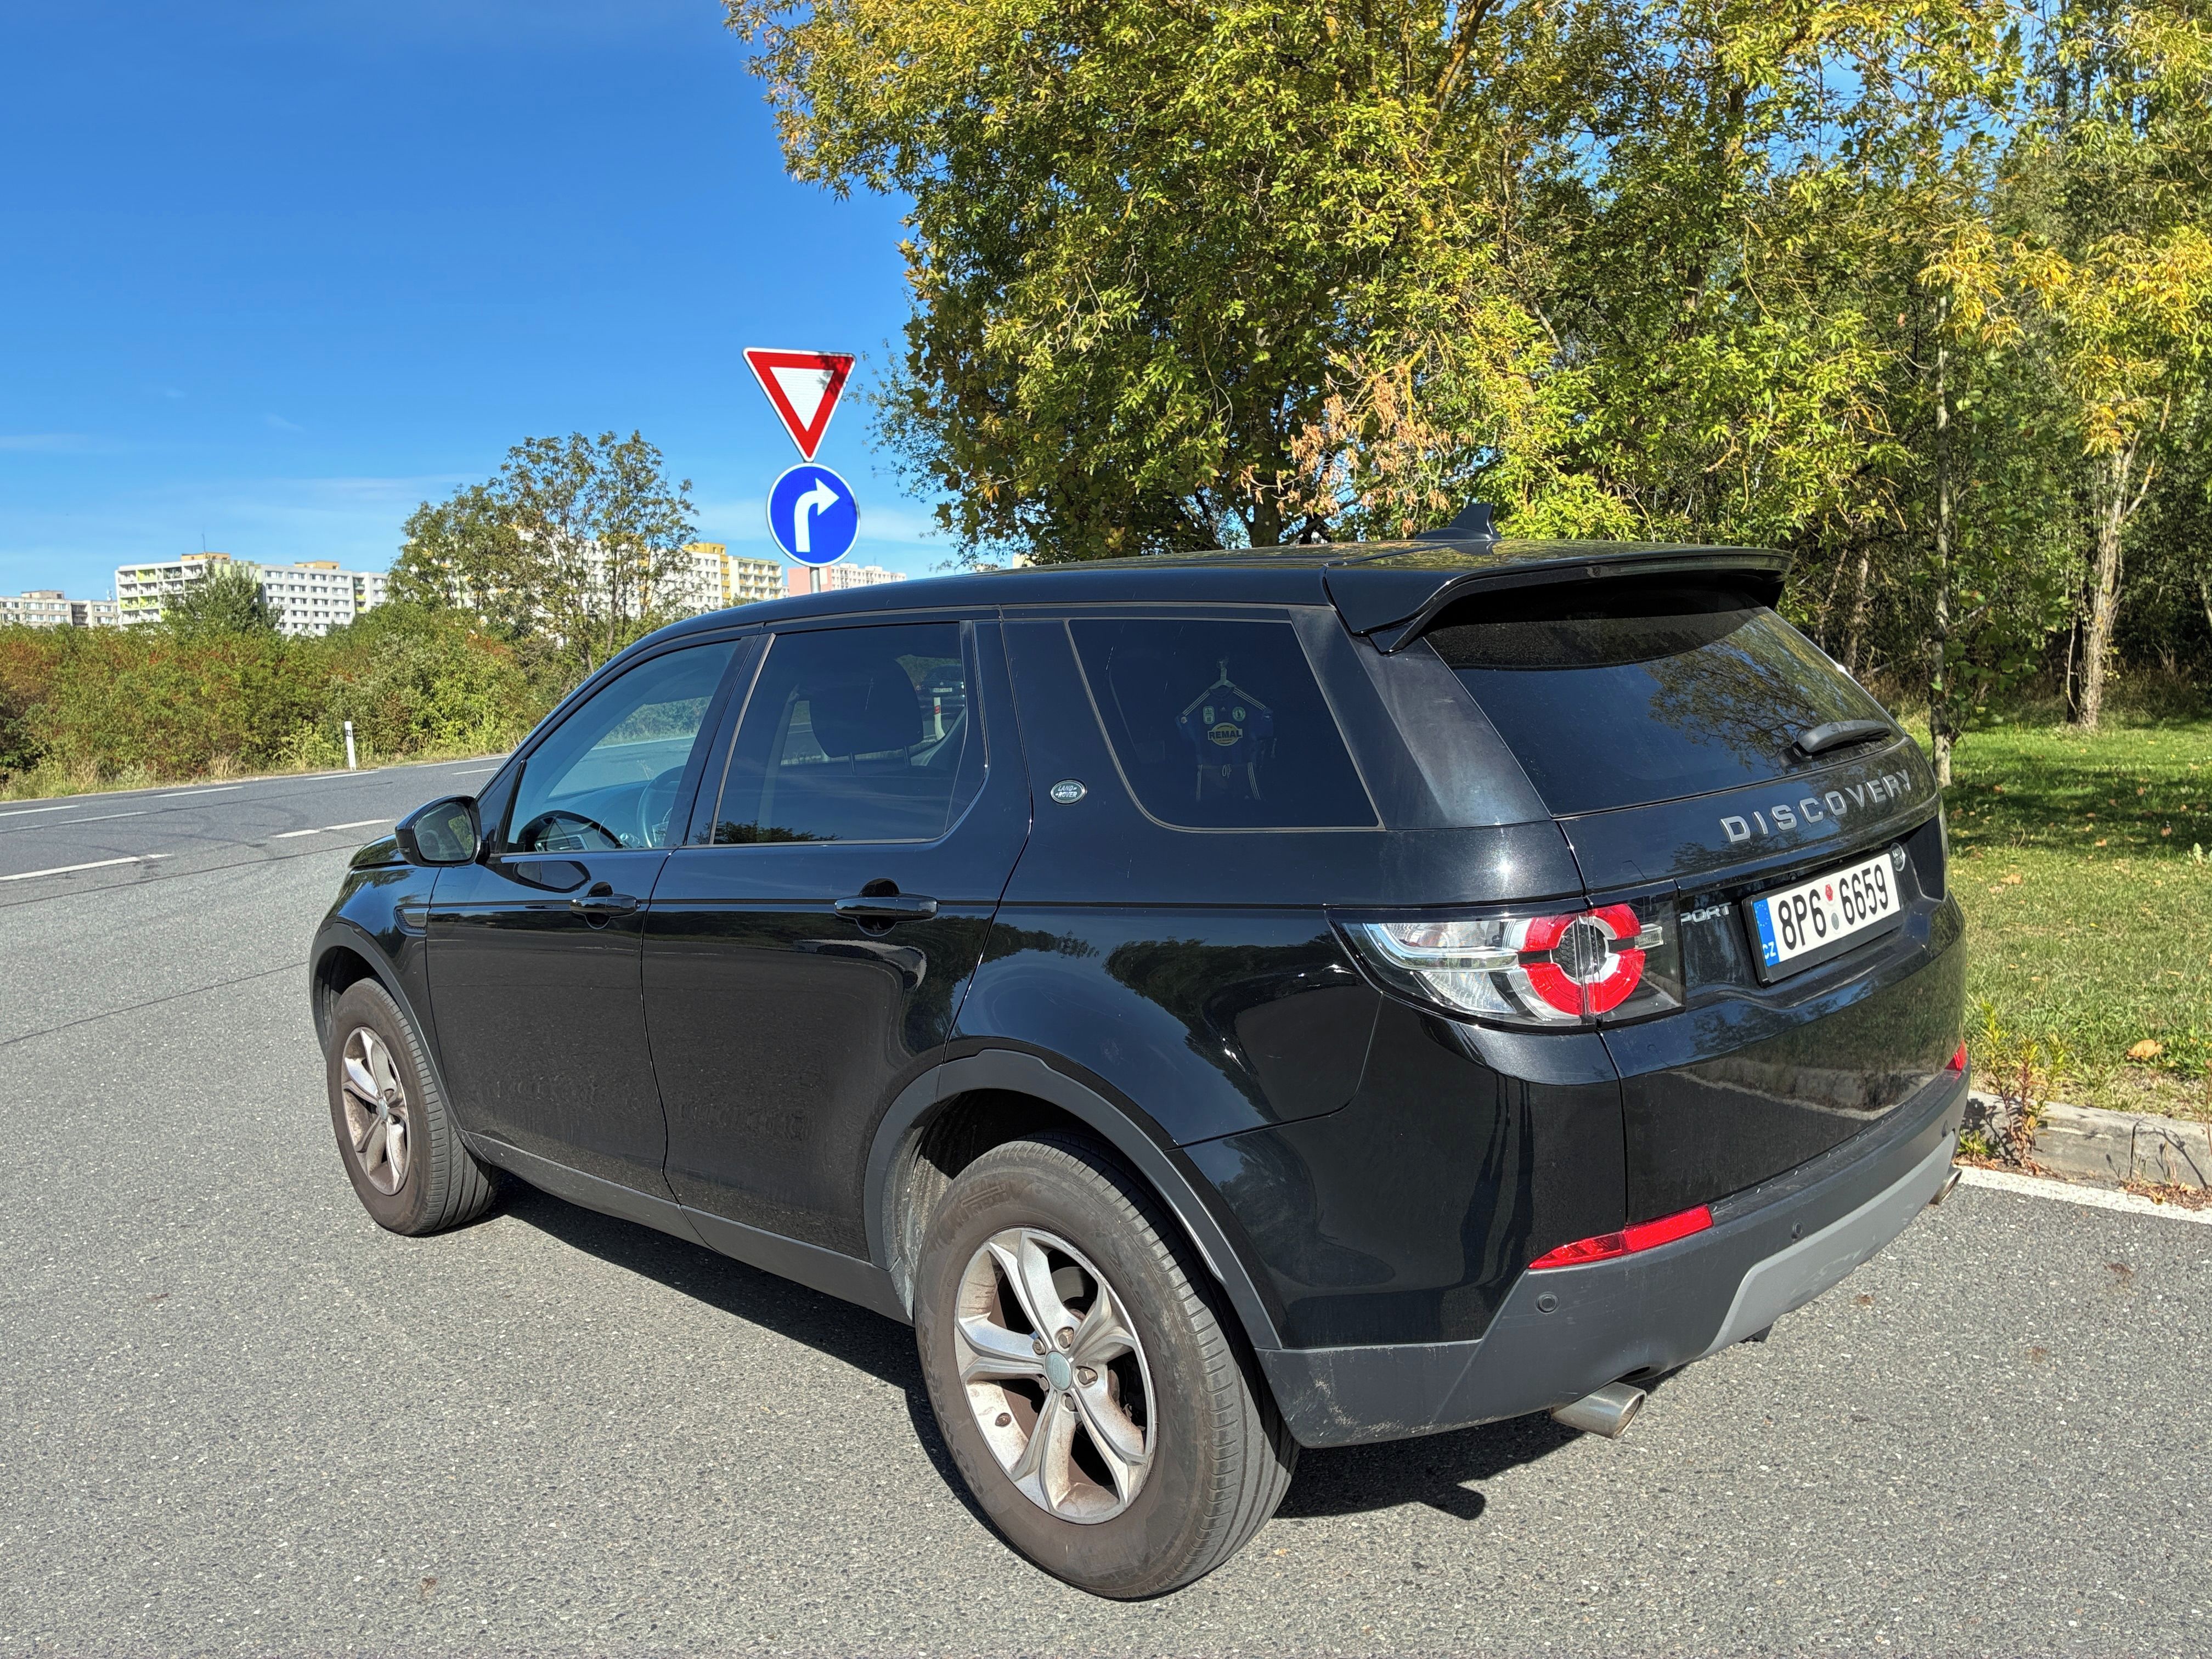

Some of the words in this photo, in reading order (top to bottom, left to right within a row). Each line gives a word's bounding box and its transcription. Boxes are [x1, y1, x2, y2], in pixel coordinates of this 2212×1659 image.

[1209, 730, 1242, 740] REMAL
[1720, 769, 1912, 843] DISCOVERY
[1680, 902, 1732, 926] PORT
[1778, 889, 1827, 951] 8P6
[1839, 864, 1889, 926] 6659
[1763, 941, 1776, 960] CZ
